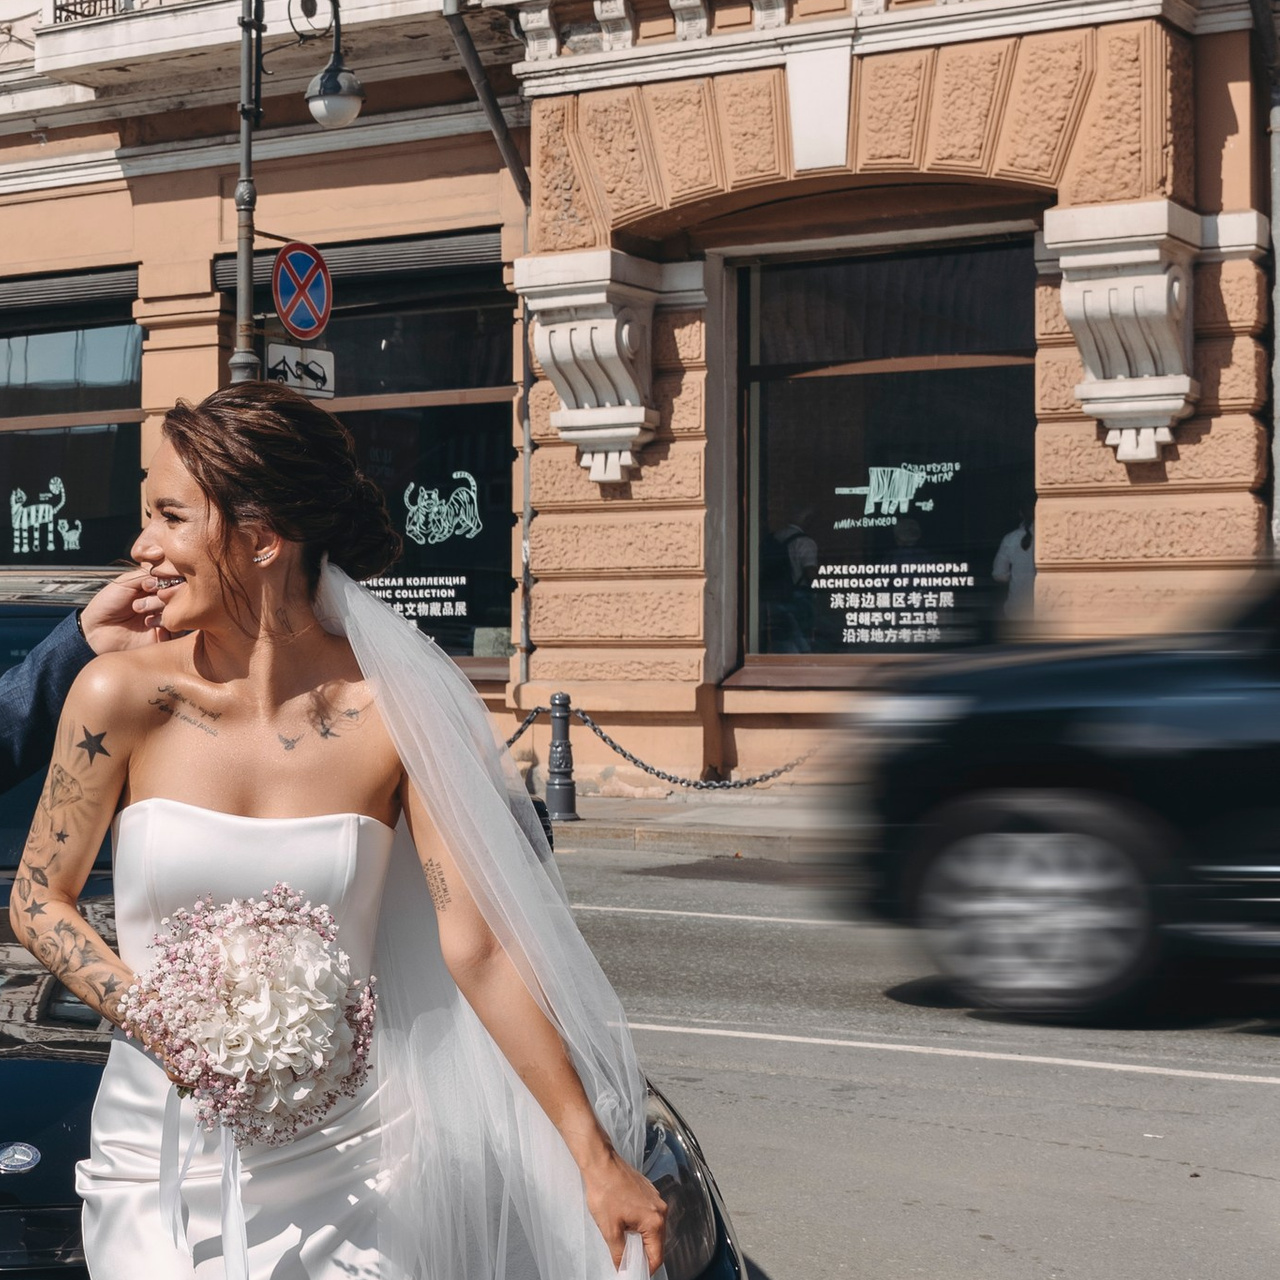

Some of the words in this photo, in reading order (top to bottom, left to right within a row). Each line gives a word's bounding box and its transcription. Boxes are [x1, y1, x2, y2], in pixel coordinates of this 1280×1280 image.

[818, 564, 897, 575] АРХЕОЛОГИЯ
[901, 563, 969, 573] ПРИМОРЬЯ
[406, 576, 466, 587] КОЛЛЕКЦИЯ
[811, 578, 890, 588] ARCHEOLOGY
[893, 578, 910, 588] OF
[913, 577, 974, 587] PRIMORYE
[395, 589, 455, 599] COLLECTION
